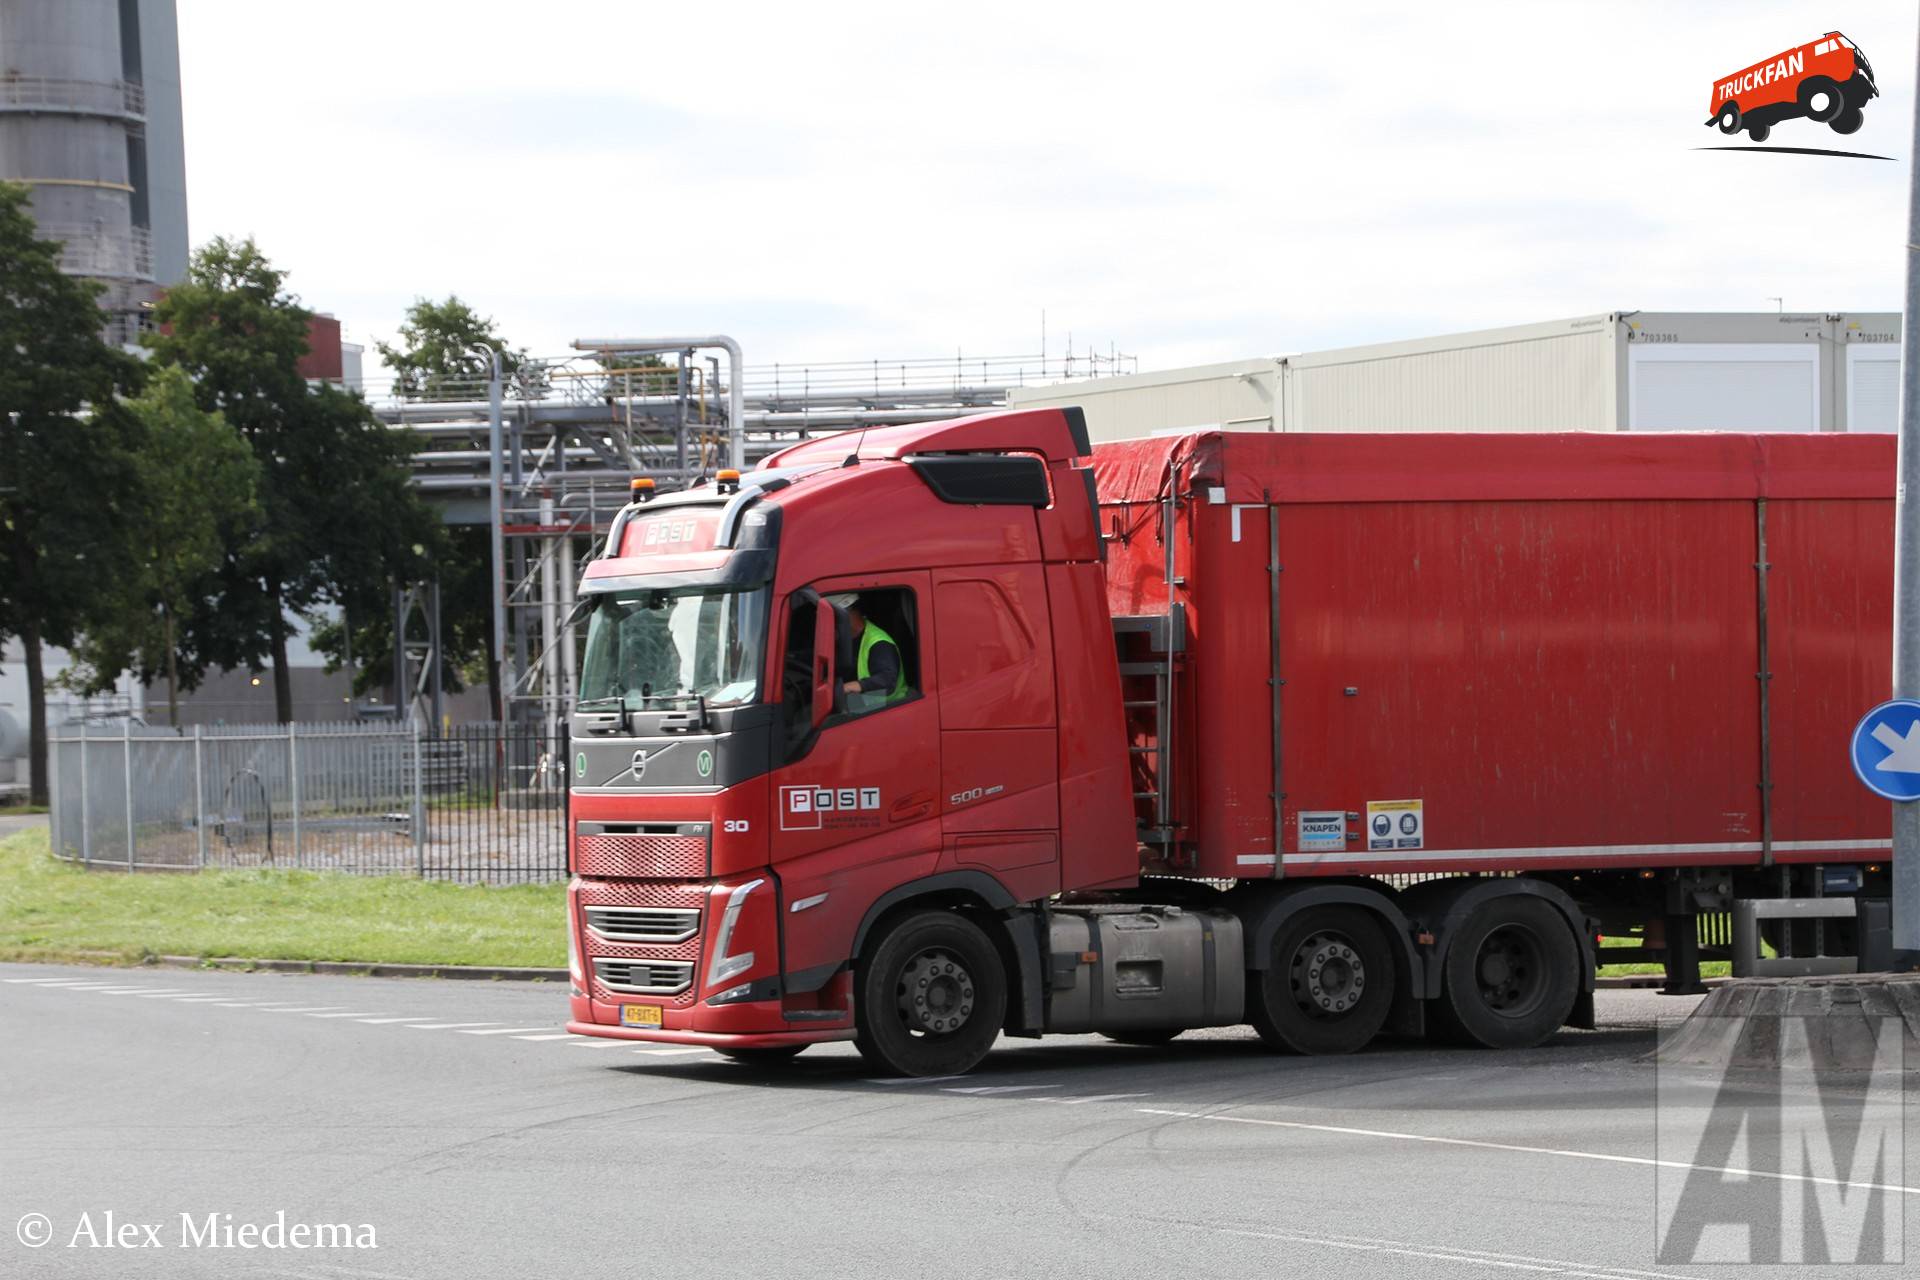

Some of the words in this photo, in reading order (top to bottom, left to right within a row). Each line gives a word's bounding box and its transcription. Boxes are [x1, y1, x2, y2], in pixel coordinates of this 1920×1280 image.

[647, 522, 696, 543] POST
[792, 789, 878, 809] POST
[951, 787, 982, 805] 500
[724, 820, 749, 832] 30
[1303, 824, 1341, 832] KNAPEN
